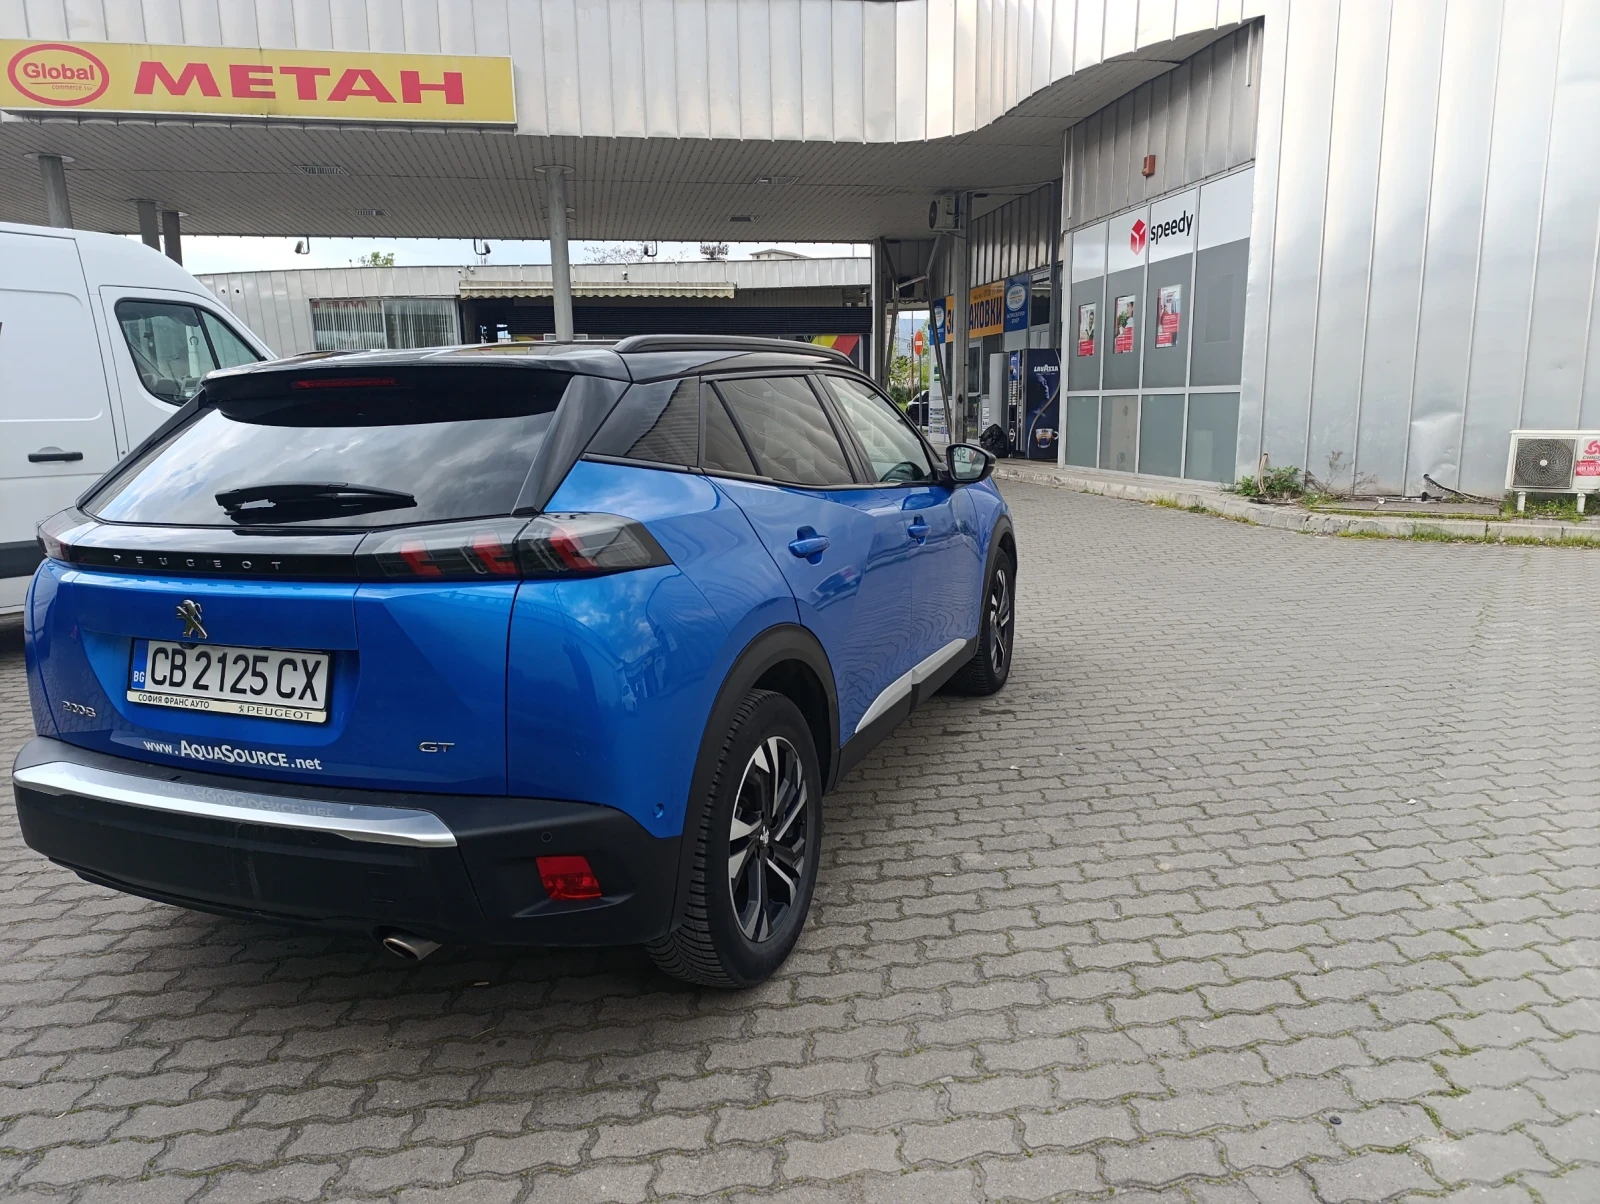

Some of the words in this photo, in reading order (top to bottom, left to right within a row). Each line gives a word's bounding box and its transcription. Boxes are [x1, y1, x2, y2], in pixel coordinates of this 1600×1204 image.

[22, 62, 95, 80] Global
[134, 61, 465, 105] МЕТАН
[1150, 210, 1194, 245] speedy
[1033, 363, 1059, 372] LAVAZZA
[113, 554, 281, 570] PEUGEOT
[133, 670, 145, 683] BG
[192, 650, 269, 696] 2125
[276, 657, 322, 702] CX
[62, 700, 97, 718] 2008
[138, 693, 162, 704] СОФИЯ
[164, 696, 189, 707] ФРАНС
[190, 698, 210, 709] АУТО
[246, 705, 313, 721] PEUGEOT
[418, 741, 456, 753] GT
